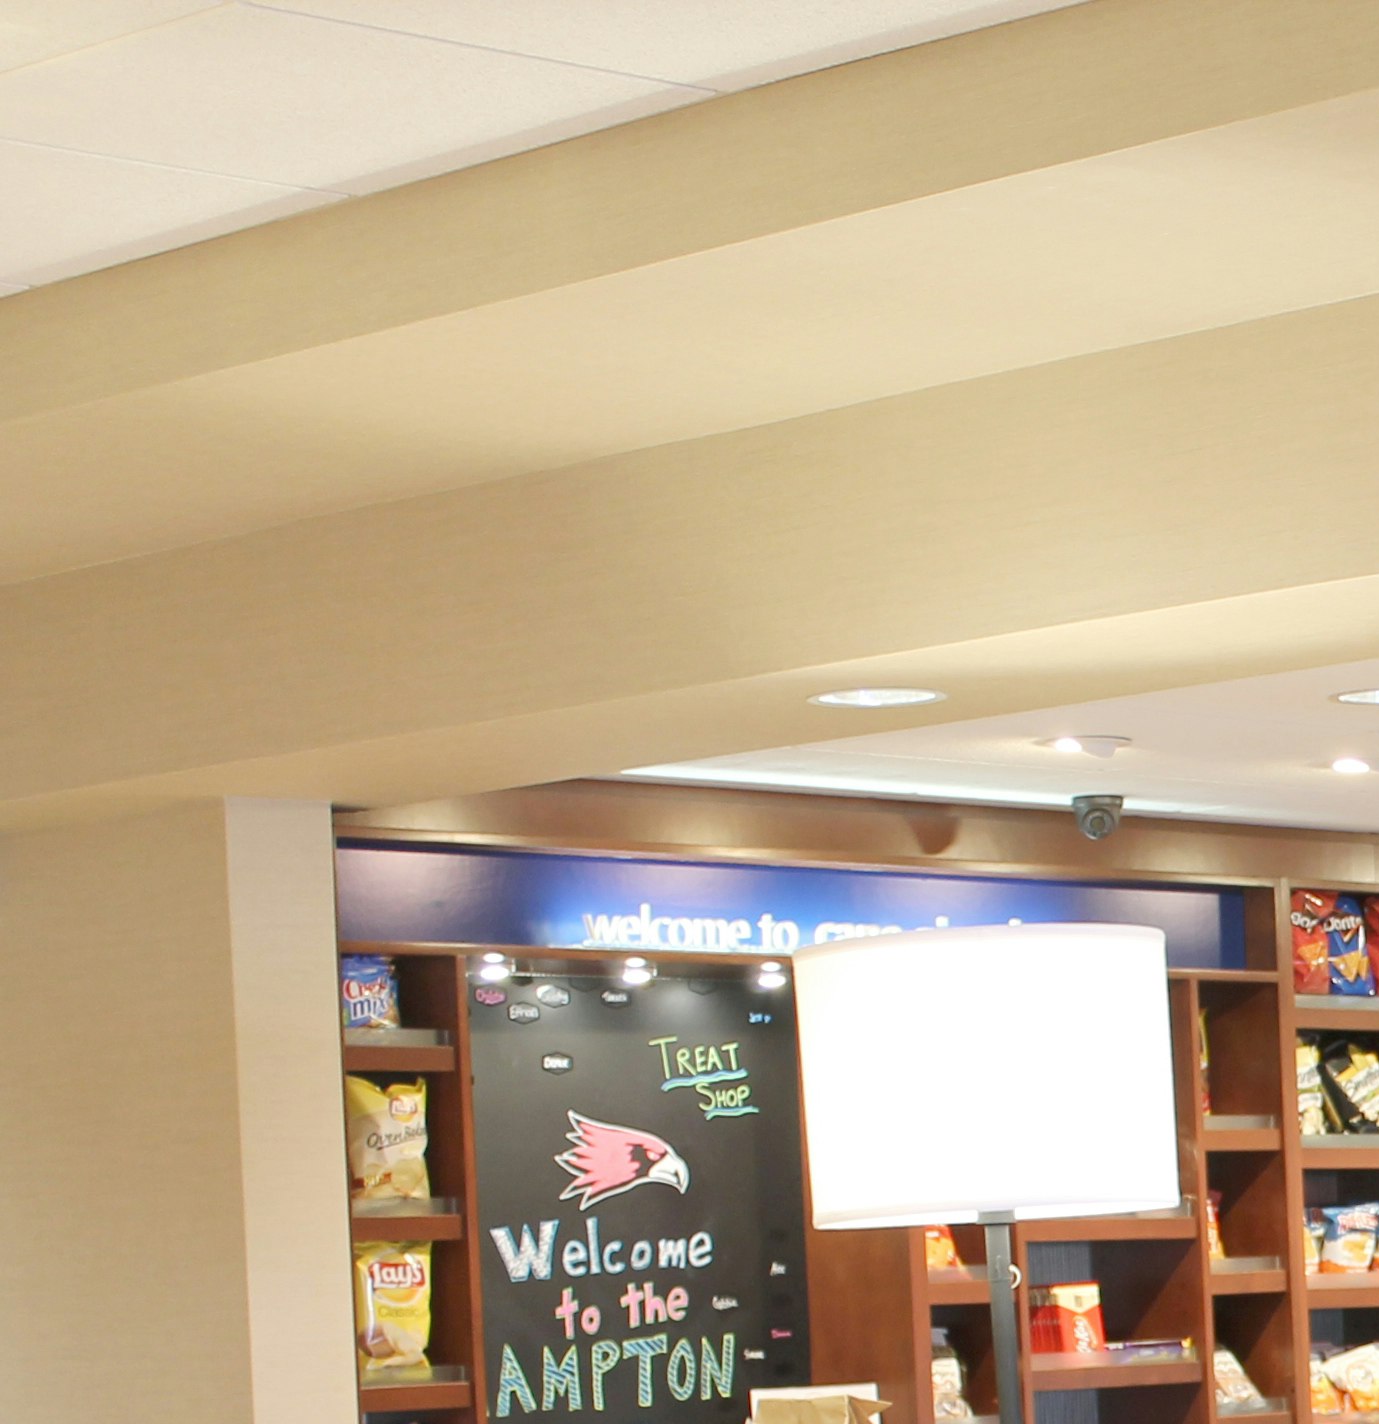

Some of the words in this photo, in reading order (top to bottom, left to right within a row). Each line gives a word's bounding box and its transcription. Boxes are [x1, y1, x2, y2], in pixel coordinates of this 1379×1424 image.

[584, 903, 751, 950] welcome
[761, 913, 798, 953] to
[648, 1036, 739, 1080] TREAT
[695, 1082, 751, 1111] SHOP
[372, 1255, 422, 1289] Lay's
[489, 1216, 713, 1283] Welcome
[555, 1286, 601, 1340] to
[619, 1282, 690, 1329] the
[487, 1332, 736, 1418] AMPTON
